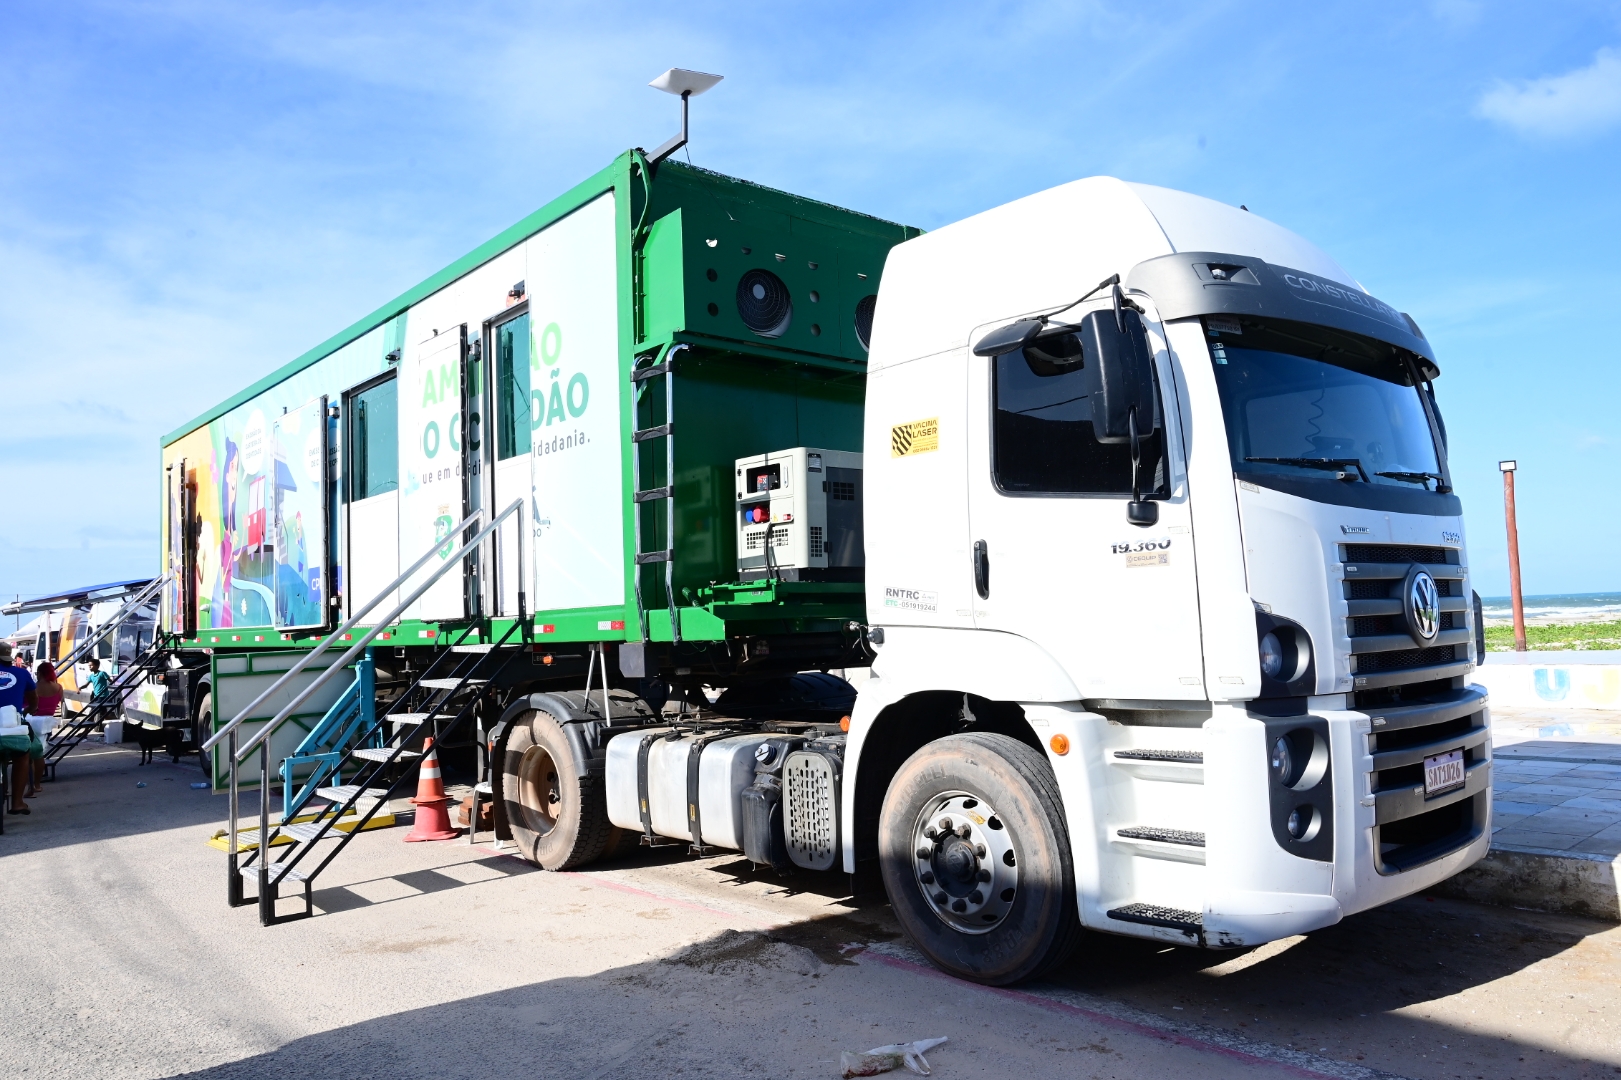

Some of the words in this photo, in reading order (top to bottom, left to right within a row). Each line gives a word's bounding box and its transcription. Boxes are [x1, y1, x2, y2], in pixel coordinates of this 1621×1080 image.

[423, 420, 440, 459] O
[912, 427, 938, 439] LASER
[533, 428, 591, 458] idadania.
[437, 467, 451, 481] em
[1111, 536, 1172, 555] 19.360
[885, 587, 920, 600] RNTRC
[885, 599, 899, 607] ETC
[1428, 761, 1461, 788] SAT1D26
[895, 764, 947, 813] PIRELLI
